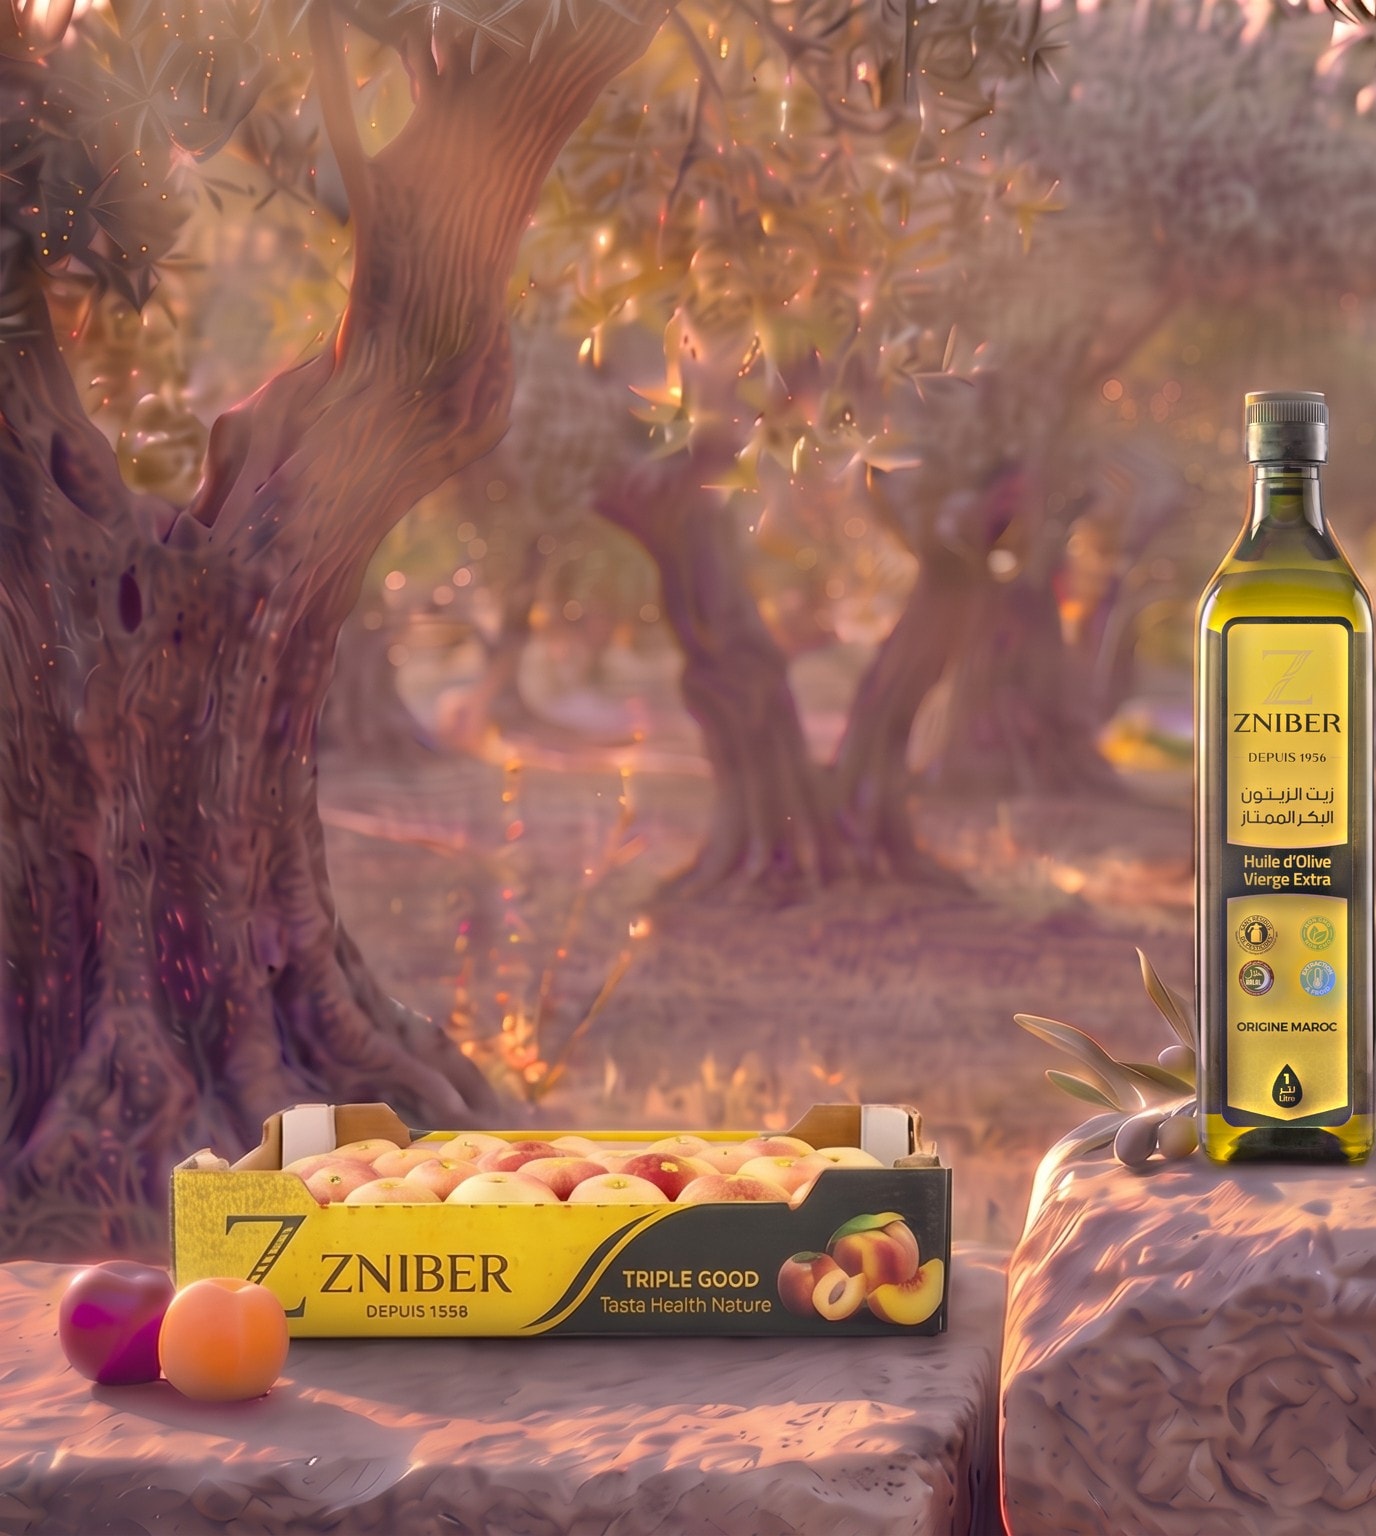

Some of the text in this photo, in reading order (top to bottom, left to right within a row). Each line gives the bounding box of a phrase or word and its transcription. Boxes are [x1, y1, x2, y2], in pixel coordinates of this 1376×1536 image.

[1262, 650, 1313, 705] Z
[1233, 713, 1341, 733] ZNIBER
[1248, 752, 1326, 763] DEPUIS 1956
[1241, 787, 1334, 804] زيت الزيتون
[1241, 810, 1334, 828] البكر الممتاز
[1244, 855, 1280, 868] Huile
[1244, 873, 1331, 889] Vierge Extra
[1305, 918, 1331, 929] NON GMO
[1302, 961, 1334, 976] EXTRACTION
[1310, 985, 1331, 996] FROID
[1237, 1022, 1337, 1032] ORIGINE MAROC
[1283, 1073, 1290, 1085] 1
[320, 1254, 512, 1293] ZNIBER
[622, 1270, 760, 1288] TRIPLE GOOD
[366, 1304, 469, 1318] DEPUIS 1558
[601, 1296, 772, 1313] Tasta Health Nature
